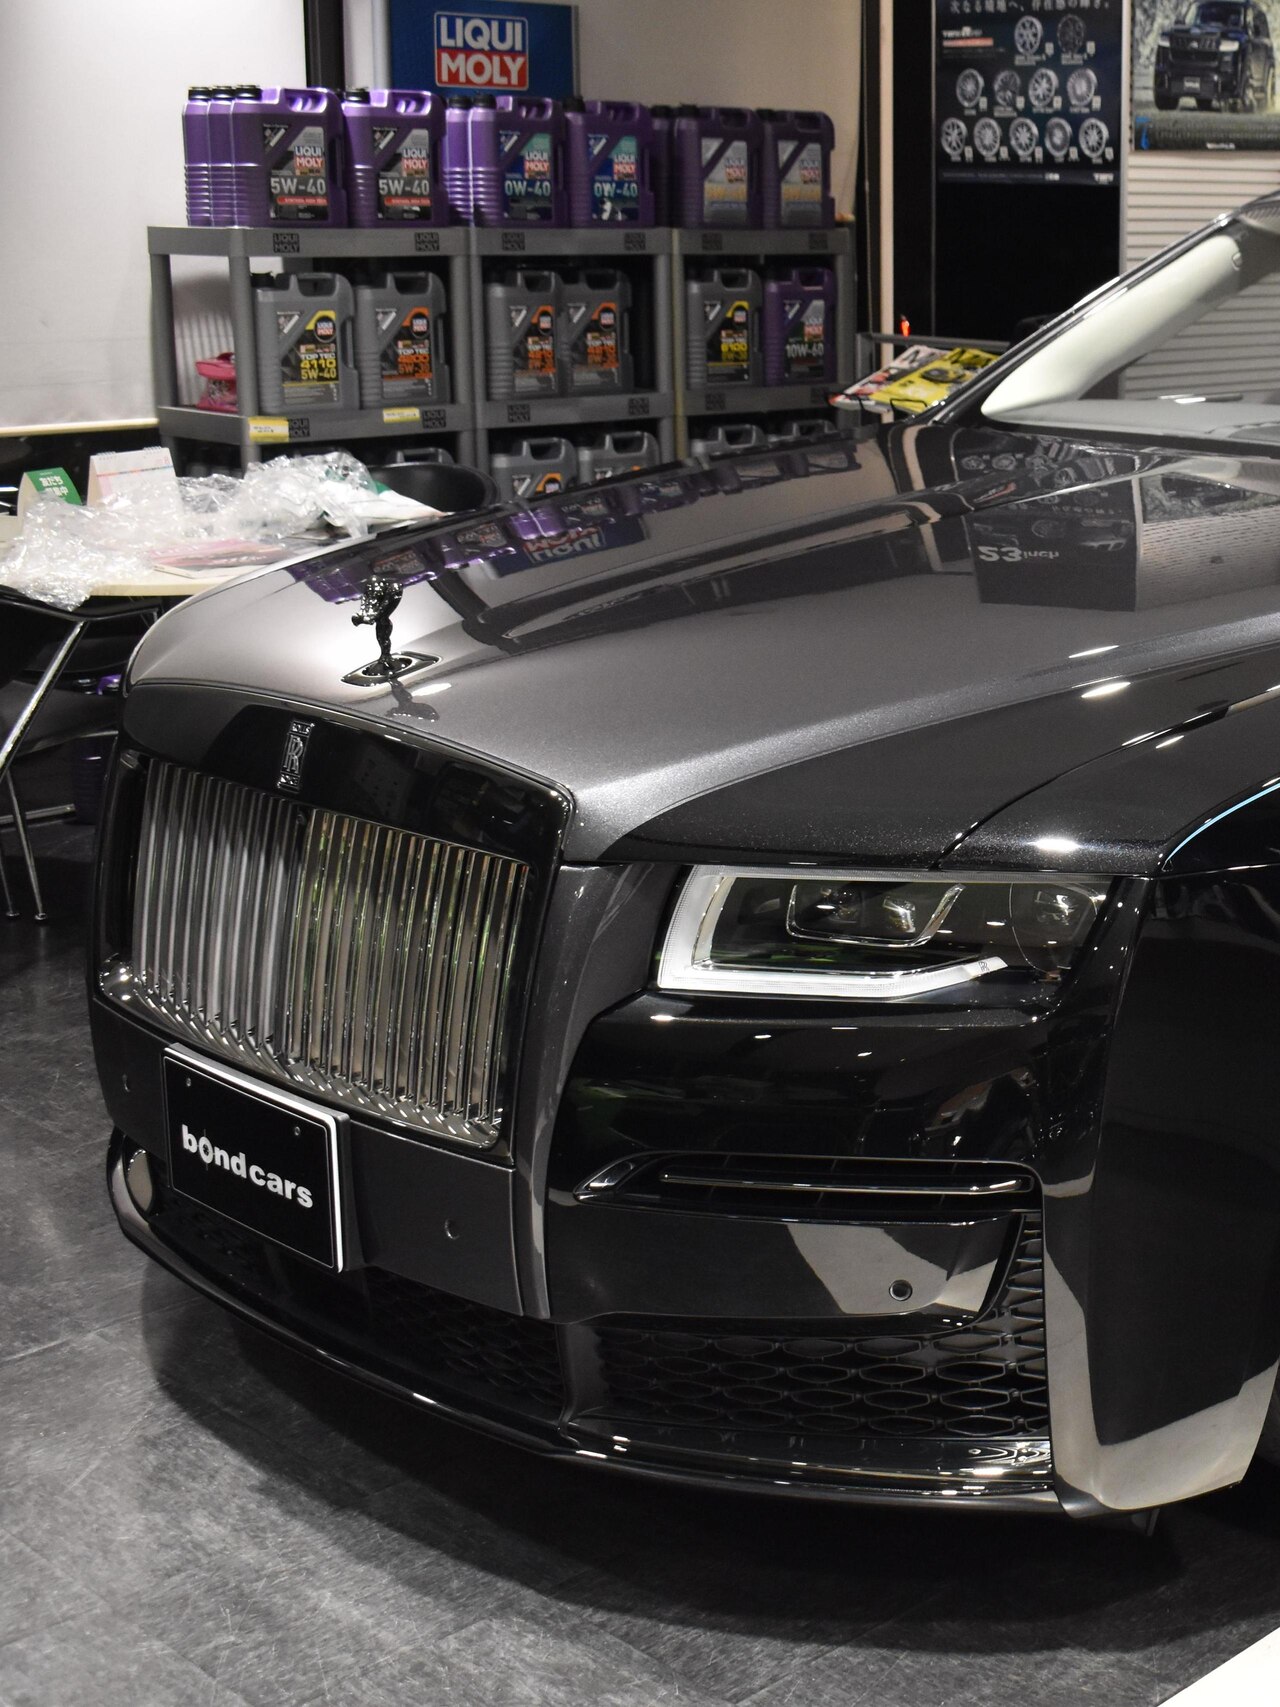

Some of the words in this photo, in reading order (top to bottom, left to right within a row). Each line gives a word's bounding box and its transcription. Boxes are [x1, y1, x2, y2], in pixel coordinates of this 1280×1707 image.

[440, 17, 523, 51] LIQUI
[441, 52, 525, 85] MOLY
[295, 146, 322, 156] LIQUI
[403, 149, 428, 159] LIQUI
[296, 157, 323, 168] MOLY
[403, 160, 428, 169] MOLY
[270, 178, 326, 194] 5W-40
[379, 179, 430, 195] 5W-40
[504, 180, 551, 196] 0W-40
[594, 182, 638, 198] 0W-40
[300, 359, 336, 368] 4110
[301, 369, 336, 380] 5W-40
